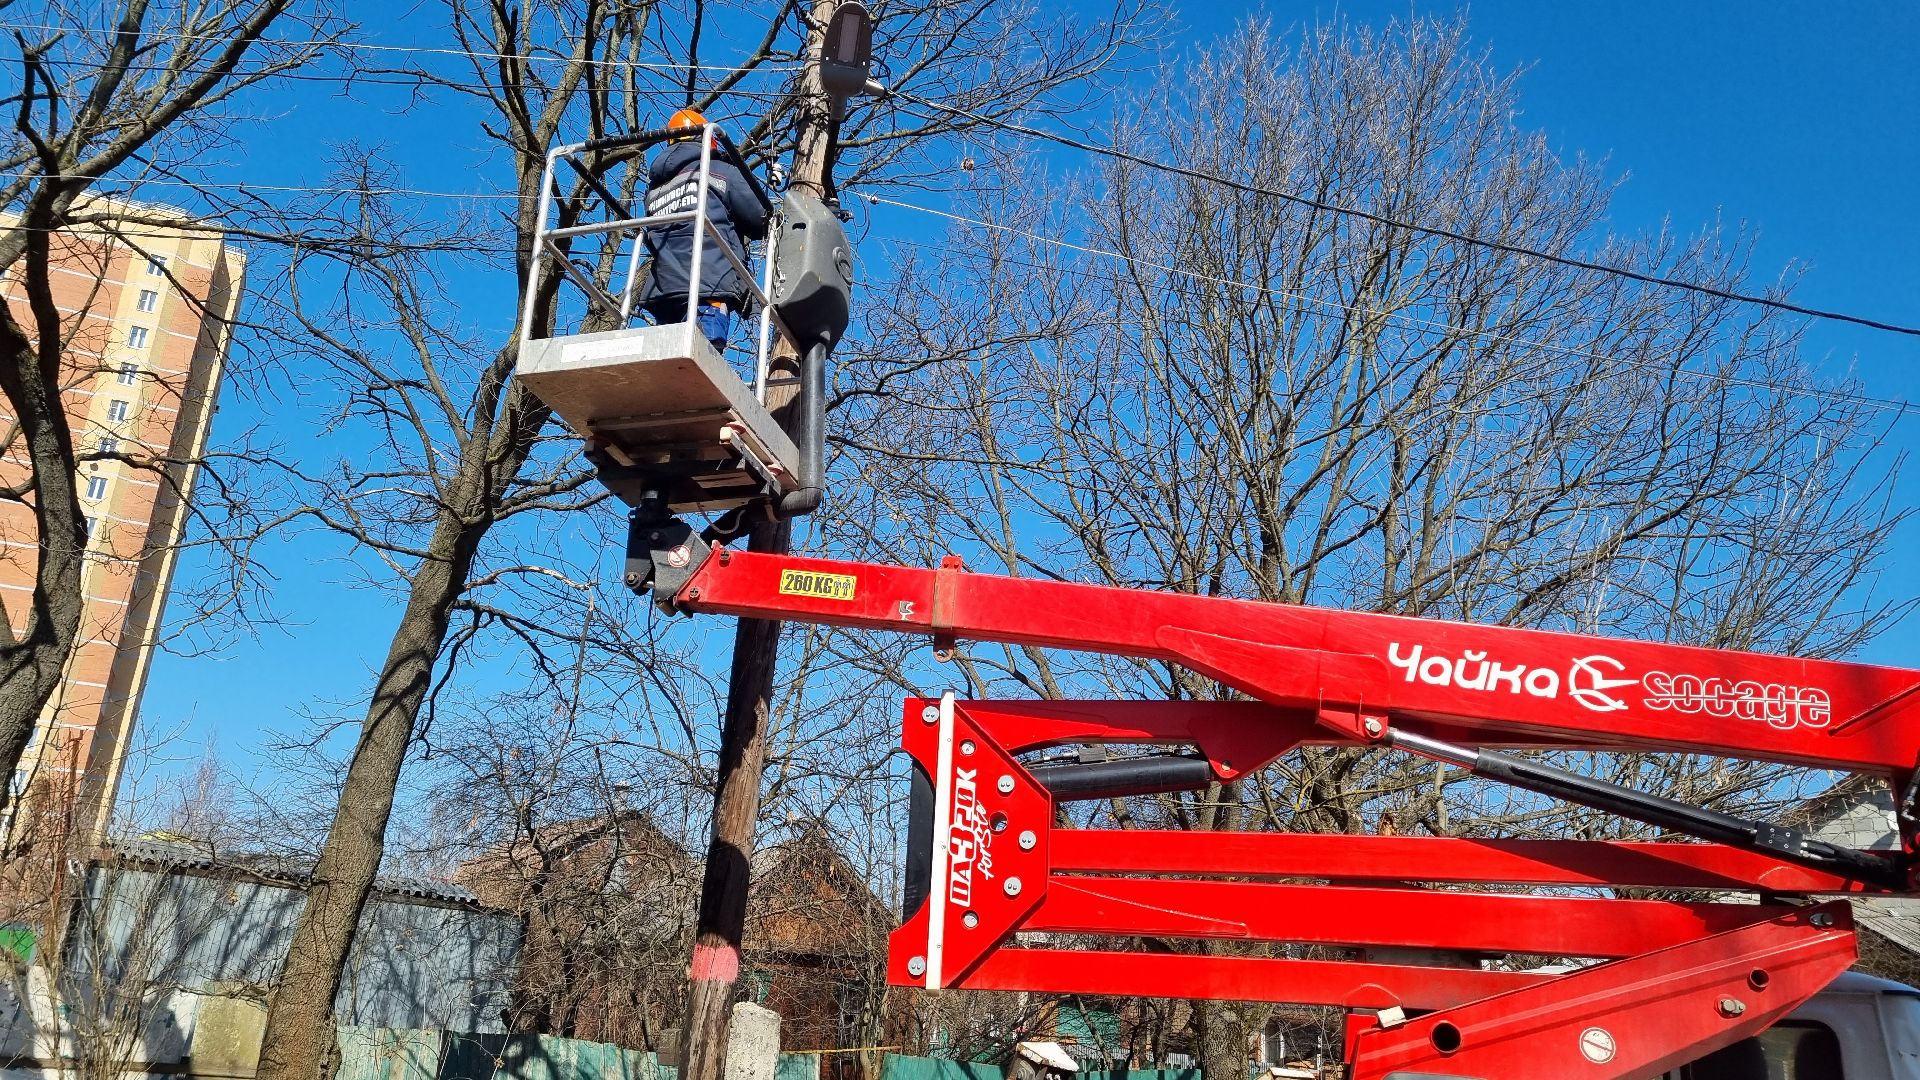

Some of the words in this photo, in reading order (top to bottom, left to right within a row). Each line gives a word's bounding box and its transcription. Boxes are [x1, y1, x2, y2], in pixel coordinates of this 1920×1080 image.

[813, 576, 834, 594] KG
[1387, 641, 1560, 699] Чайка
[1642, 671, 1831, 730] socage
